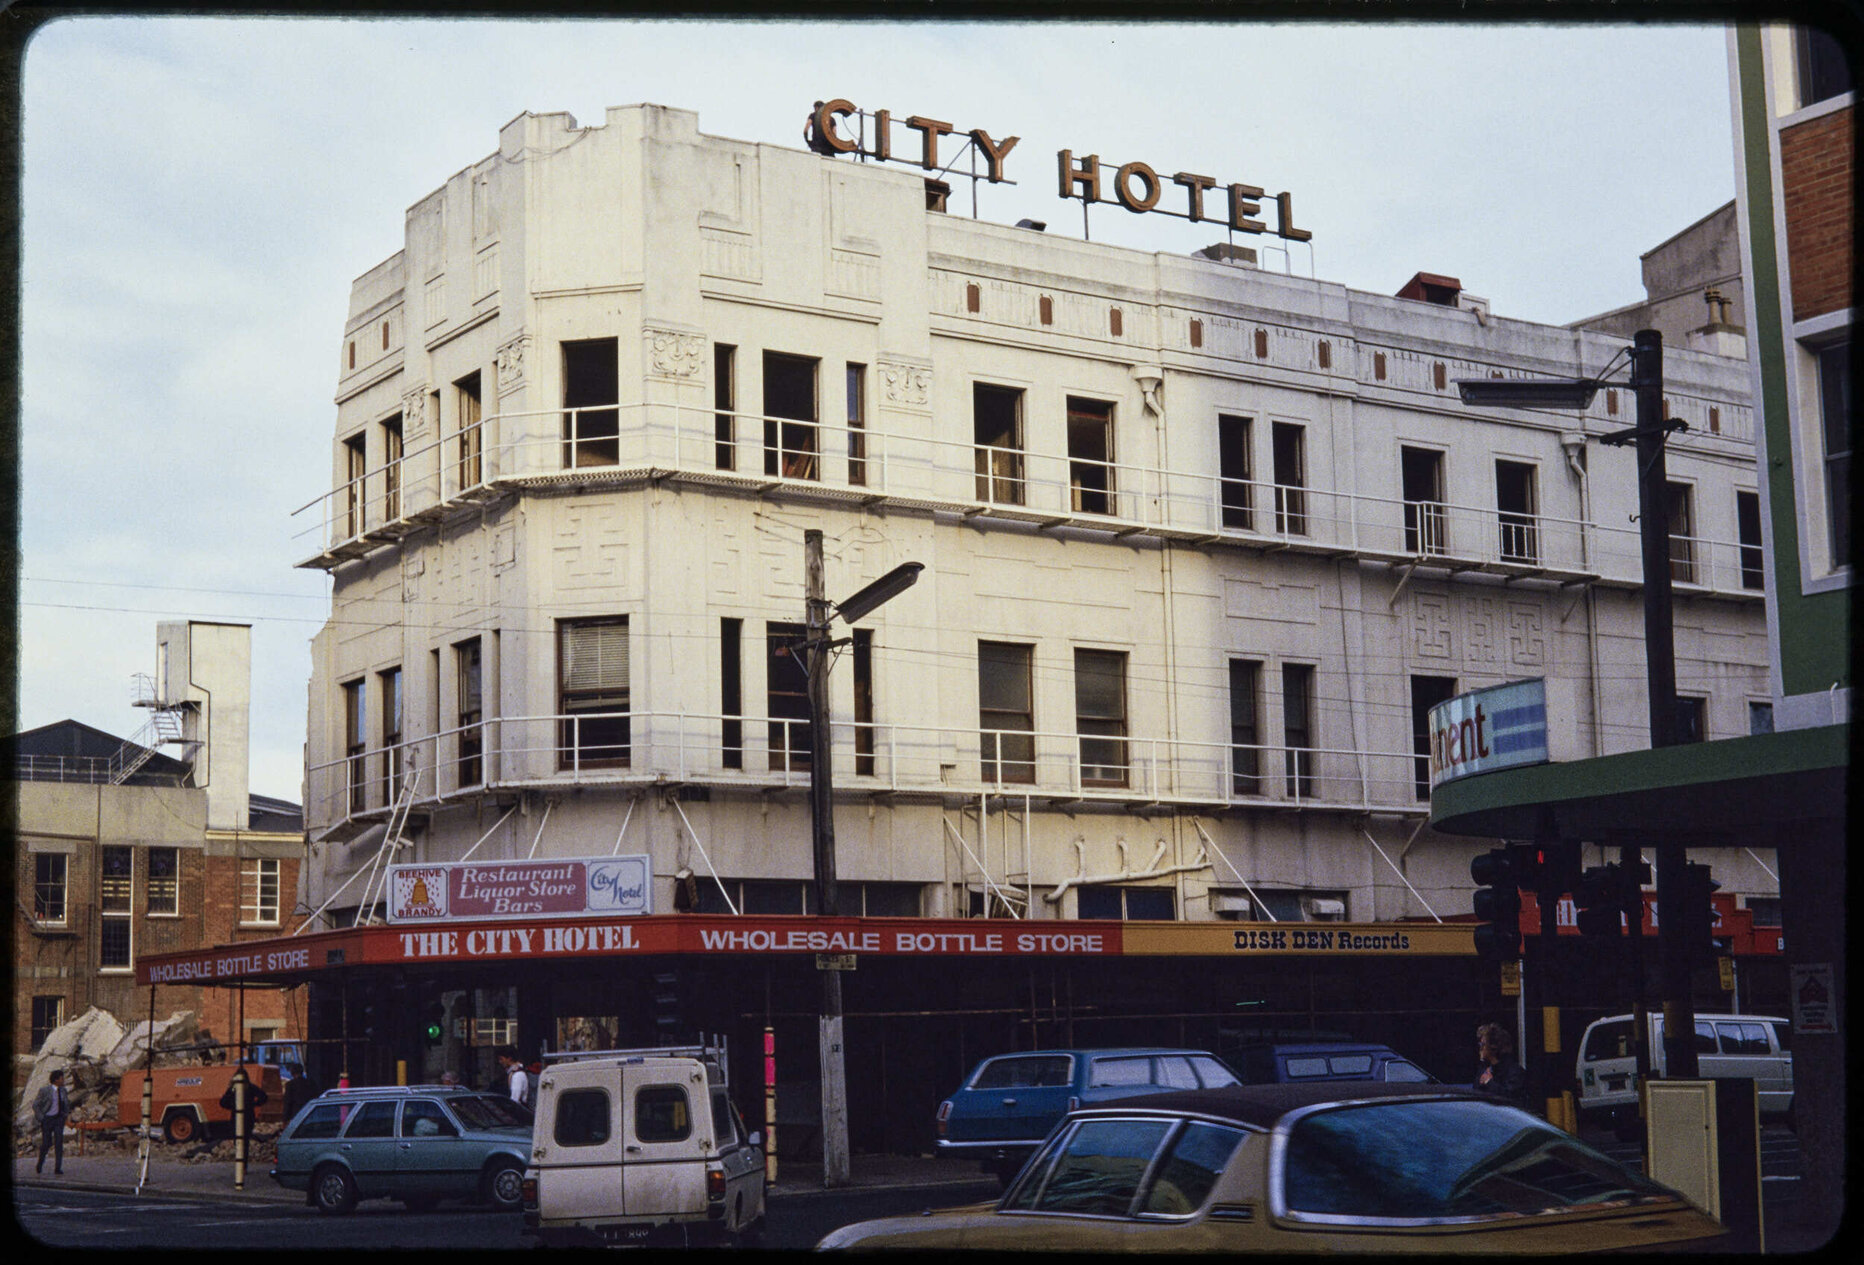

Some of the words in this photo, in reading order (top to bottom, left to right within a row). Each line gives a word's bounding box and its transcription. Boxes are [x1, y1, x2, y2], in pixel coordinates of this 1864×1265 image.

[813, 98, 1021, 184] CITY
[1057, 148, 1313, 243] HOTEL
[398, 868, 442, 881] BEEHIVE
[462, 864, 573, 884] Restaurant
[590, 865, 617, 891] City
[459, 884, 525, 904] Liquor
[529, 881, 577, 897] Store
[398, 907, 442, 919] BRANDY
[493, 898, 543, 914] Bars
[400, 931, 458, 957] THE
[466, 928, 537, 955] CITY
[543, 925, 639, 953] HOTEL
[700, 929, 880, 951] WHOLESALE
[896, 932, 1002, 952] BOTTLE
[1017, 933, 1103, 952] STORE
[1234, 930, 1287, 950] DISK
[1292, 930, 1334, 950] DEN
[1338, 931, 1410, 951] Records
[150, 960, 212, 983] WHOLESALE
[216, 954, 262, 977] BOTTLE
[267, 949, 309, 971] STORE
